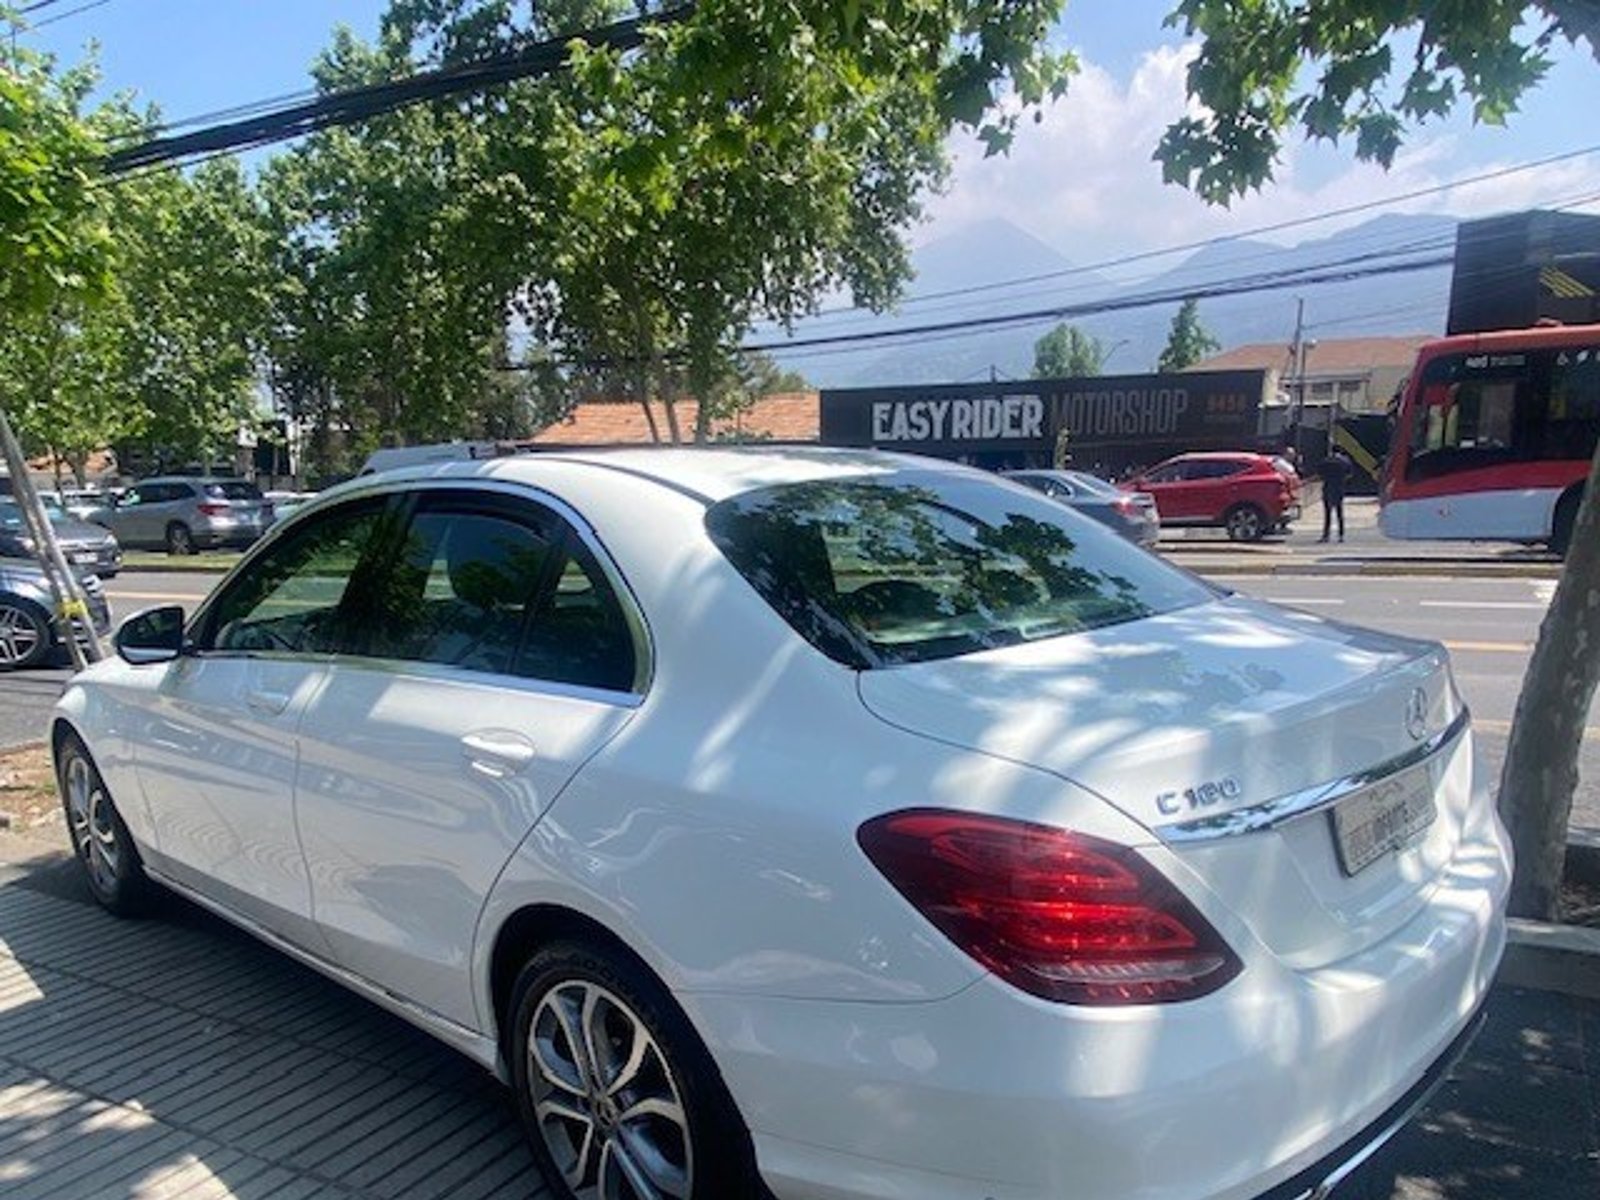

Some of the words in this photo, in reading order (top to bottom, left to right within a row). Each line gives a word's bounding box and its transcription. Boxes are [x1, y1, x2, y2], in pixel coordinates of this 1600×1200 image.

[872, 402, 950, 441] EASY
[951, 395, 1043, 439] RIDER
[1049, 388, 1188, 436] MOTORSHOP
[1183, 776, 1241, 810] 180
